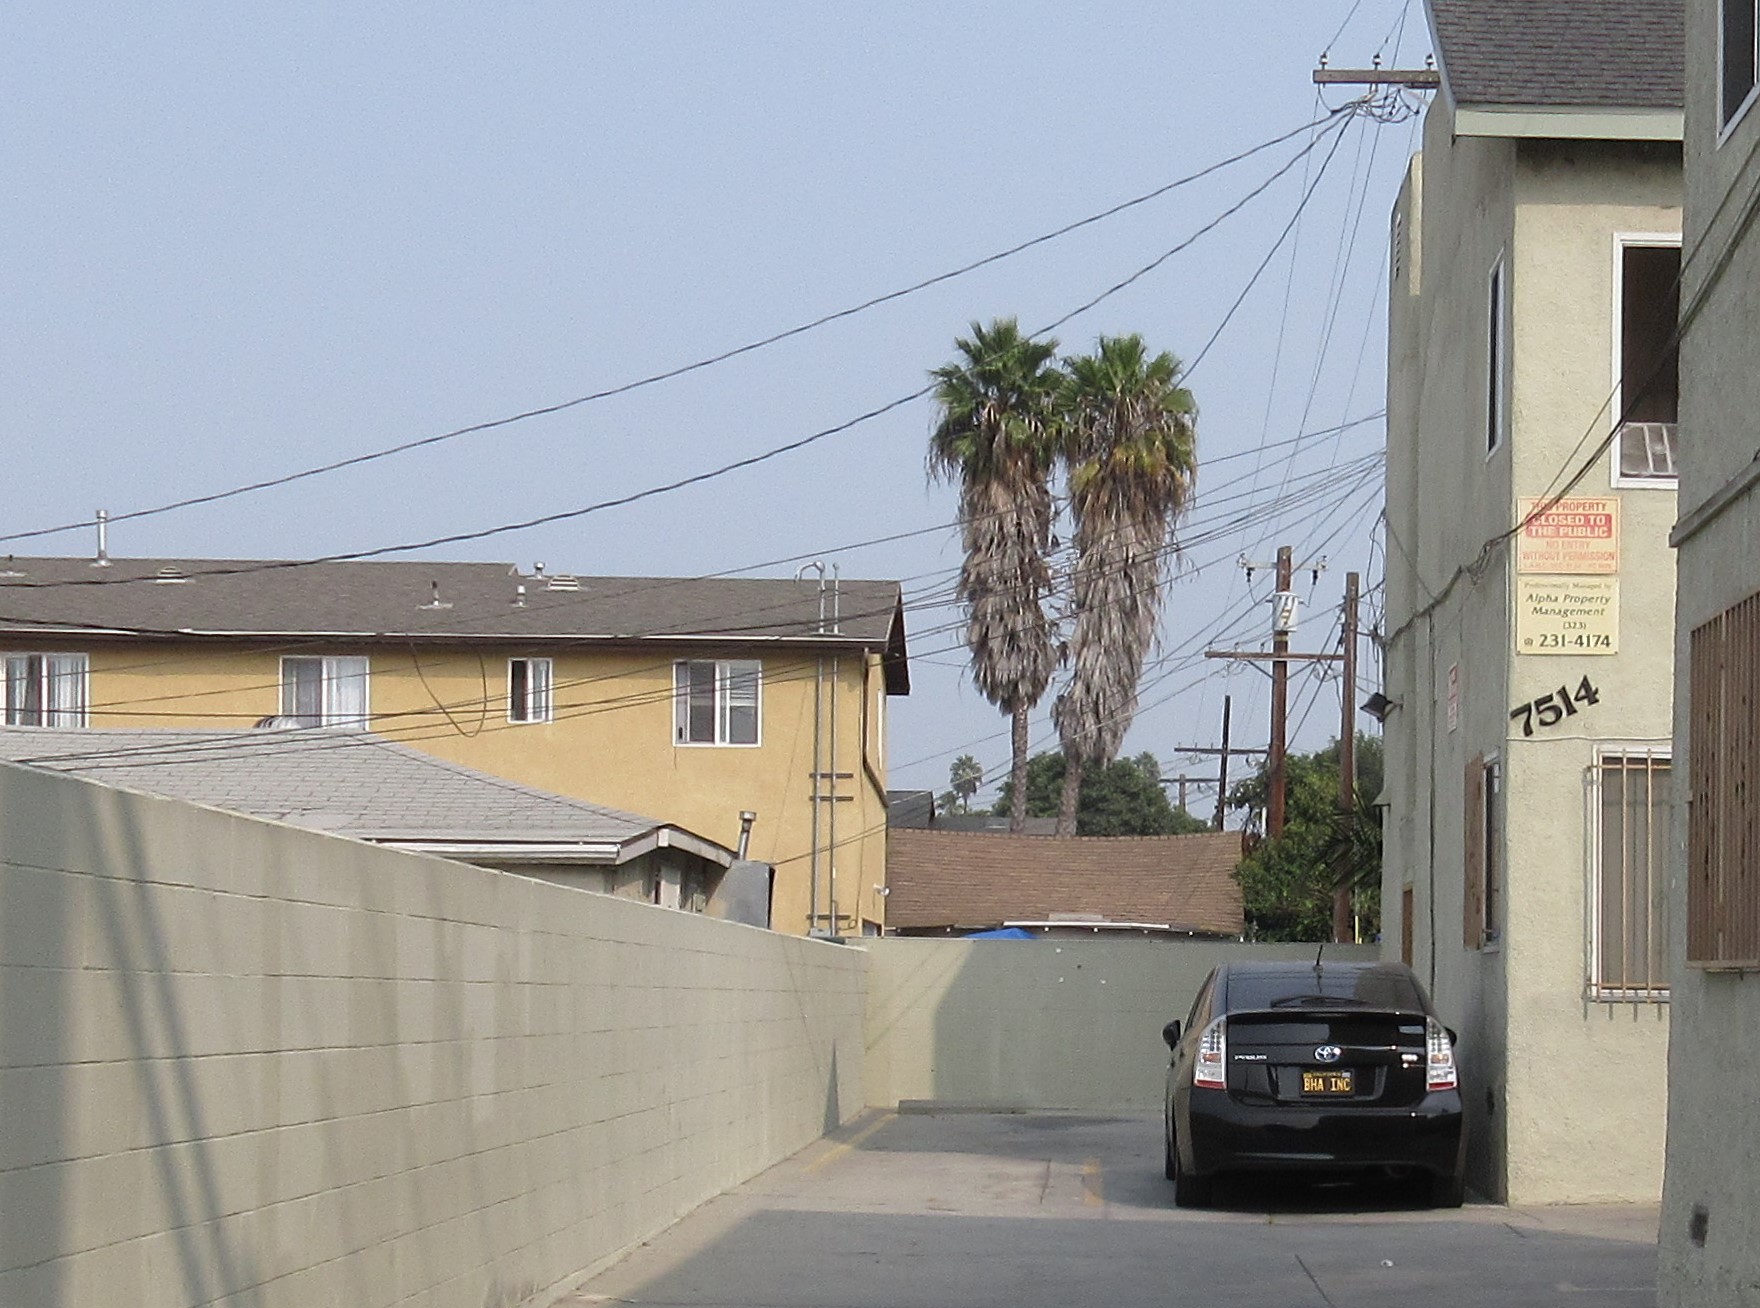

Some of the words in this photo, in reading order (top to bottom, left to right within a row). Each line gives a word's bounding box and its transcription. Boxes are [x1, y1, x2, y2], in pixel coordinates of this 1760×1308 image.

[1556, 502, 1607, 511] PROPERTY
[1588, 515, 1606, 525] TO
[1530, 527, 1556, 537] THE
[1559, 527, 1608, 537] PUBLIC
[1546, 540, 1559, 550] NO
[1561, 540, 1591, 550] ENTRY
[1525, 593, 1558, 604] Alpha
[1562, 594, 1611, 605] Property
[1531, 606, 1606, 618] Management
[1562, 621, 1587, 630] (323)
[1539, 634, 1611, 647] 231-4174
[1510, 674, 1600, 737] 7514
[1304, 1078, 1324, 1091] BHA
[1331, 1078, 1350, 1091] INC
